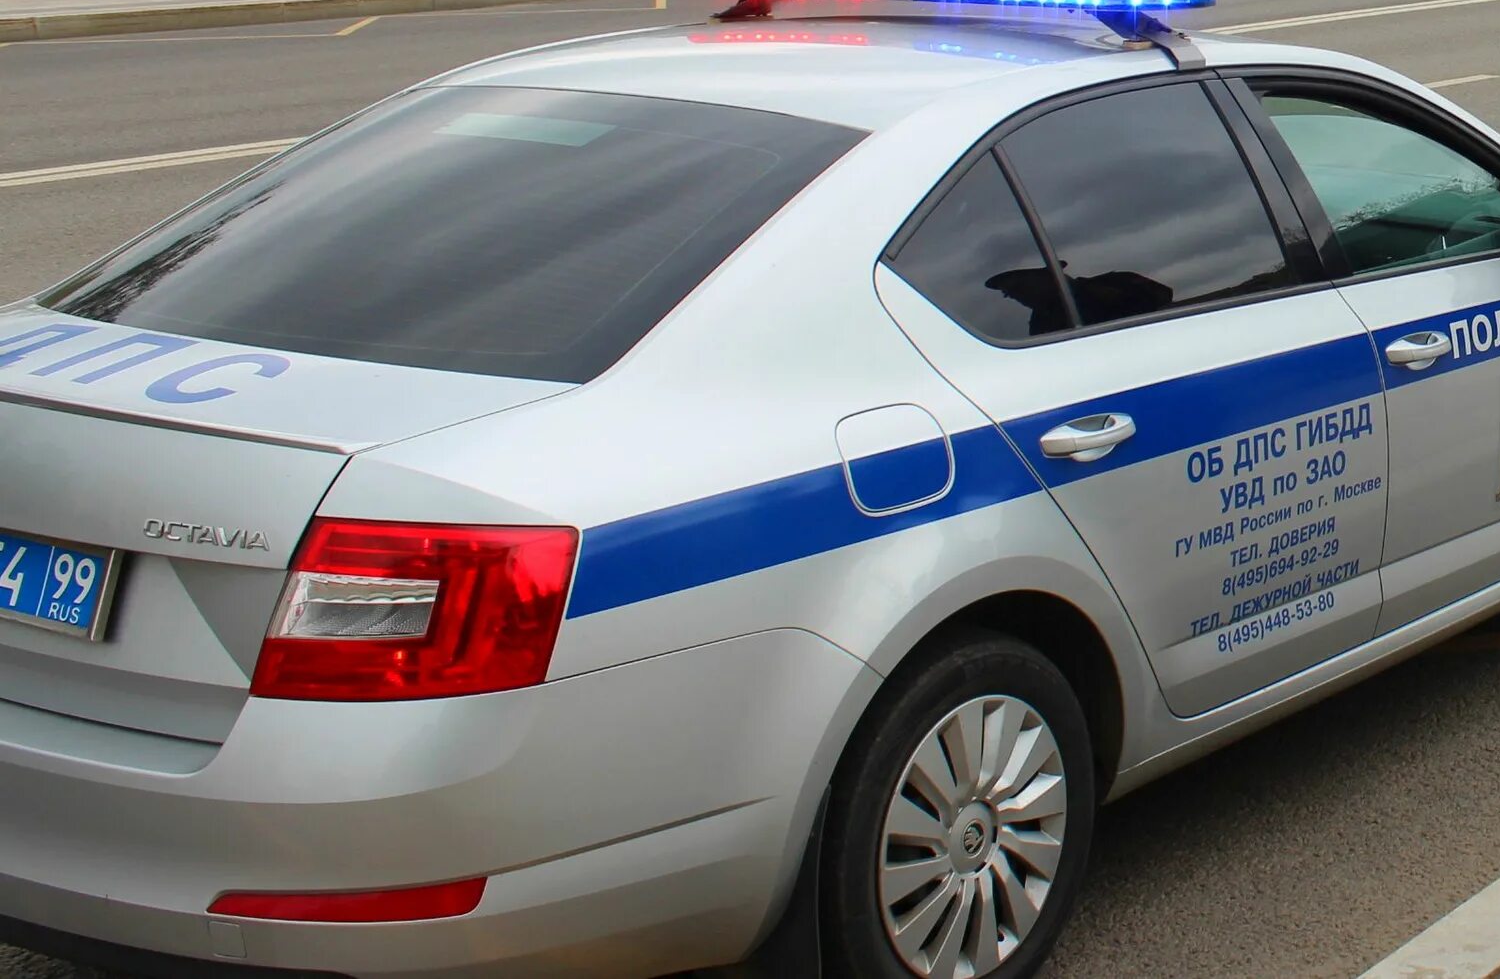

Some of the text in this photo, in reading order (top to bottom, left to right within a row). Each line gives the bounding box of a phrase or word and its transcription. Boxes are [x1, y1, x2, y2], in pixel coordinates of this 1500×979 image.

[1187, 403, 1373, 484] ОБ ДПС ГИБДД
[1220, 450, 1346, 514] УВД по ЗАО
[143, 518, 270, 552] OCTAVIA
[1175, 476, 1382, 558] ГУ МВД России по г. Москве
[1230, 516, 1337, 568] ТЕЛ. ДОВЕРИЯ
[0, 541, 96, 607] 4 99
[1190, 559, 1360, 638] ТЕЛ. ДЕЖУРНОЙ ЧАСТИ
[1221, 538, 1339, 596] 8(495)694-92-29
[48, 602, 80, 624] RUS
[1217, 591, 1335, 653] 8(495)448-53-80
